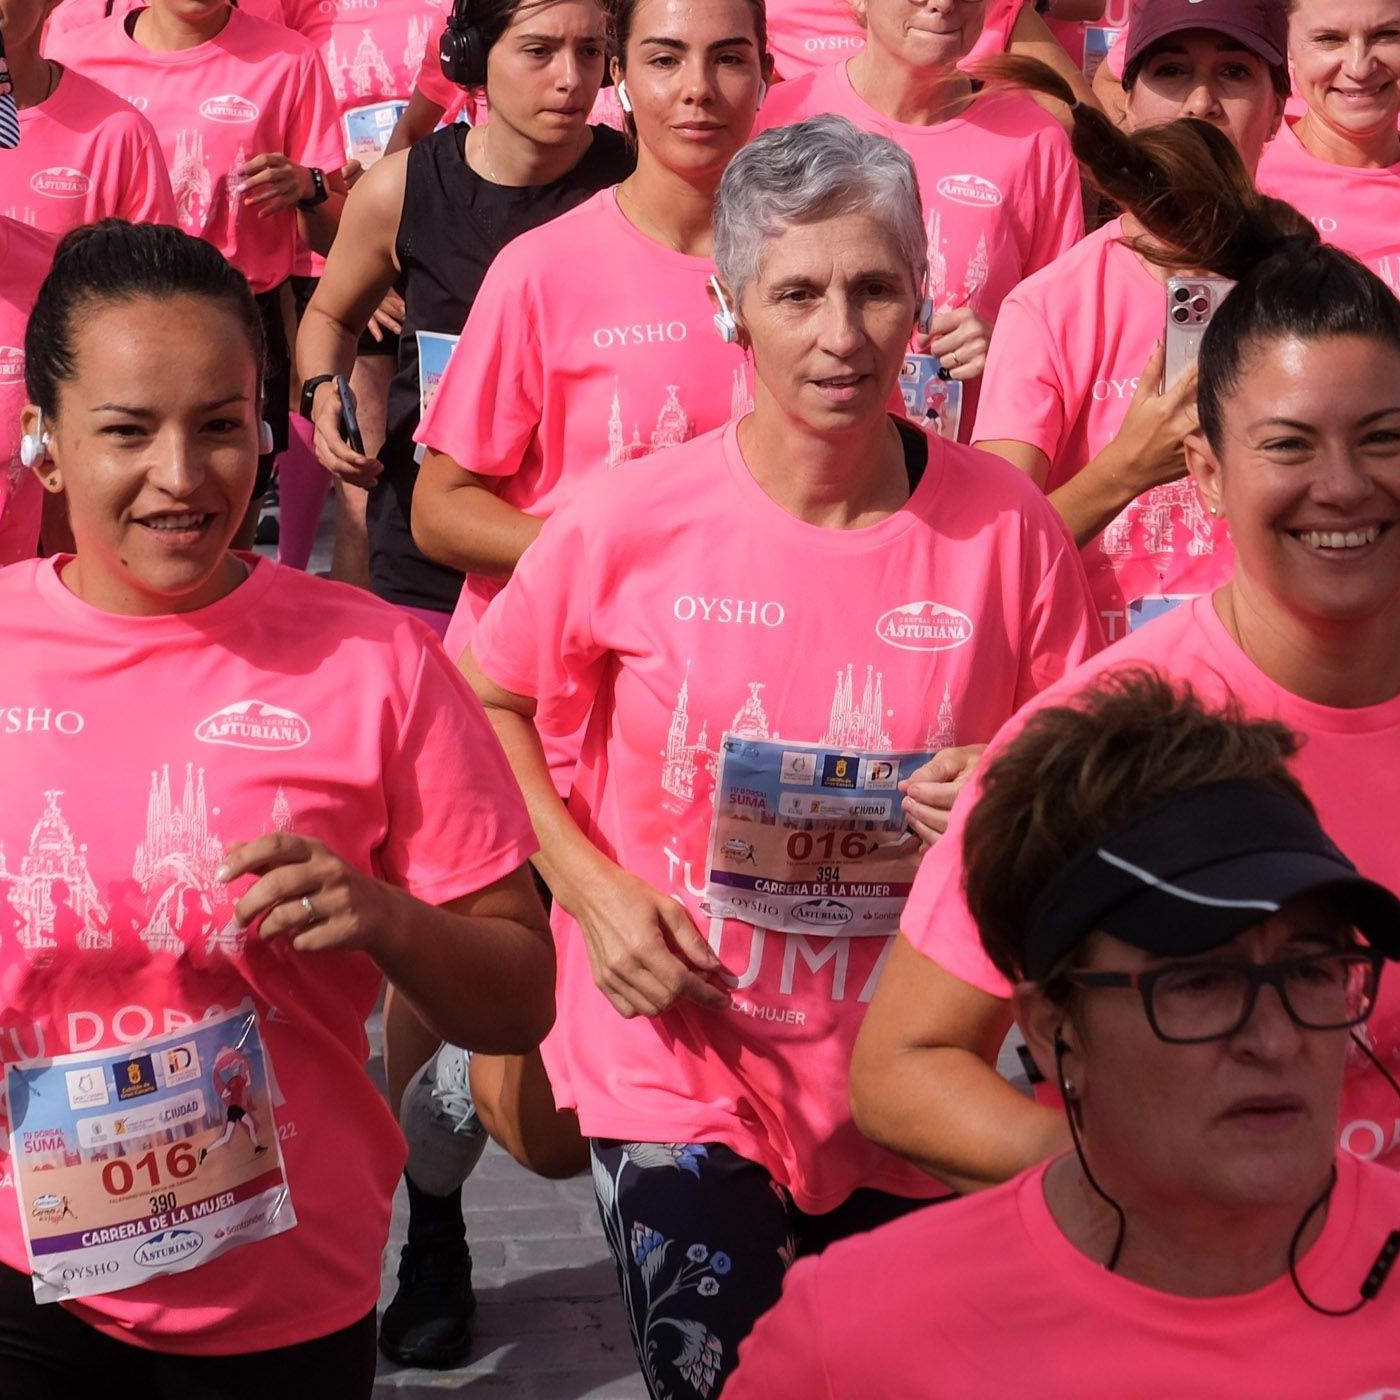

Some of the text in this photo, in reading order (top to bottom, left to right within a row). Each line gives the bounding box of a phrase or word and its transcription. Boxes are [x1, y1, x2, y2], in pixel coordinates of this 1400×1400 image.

[804, 36, 865, 52] OYSHO
[593, 321, 687, 348] OYSHO
[673, 595, 786, 627] OYSHO
[882, 621, 966, 640] ASTURIANA
[205, 721, 302, 743] ASTURIANA
[729, 794, 767, 809] SUMA
[853, 805, 886, 816] CIUDAD
[787, 831, 867, 861] 016
[816, 866, 840, 882] 394
[754, 879, 891, 897] CARRERA DE LA MUJER
[730, 896, 780, 917] OYSHO
[796, 904, 849, 921] ASTURIANA
[730, 998, 806, 1027] LA MUJER
[164, 1101, 199, 1121] CIUDAD
[24, 1137, 66, 1154] SUMA
[101, 1142, 198, 1197] 016
[149, 1192, 178, 1215] 390
[81, 1191, 236, 1249] CARRERA DE LA MUJER
[139, 1237, 200, 1264] ASTURIANA
[62, 1260, 120, 1281] OYSHO
